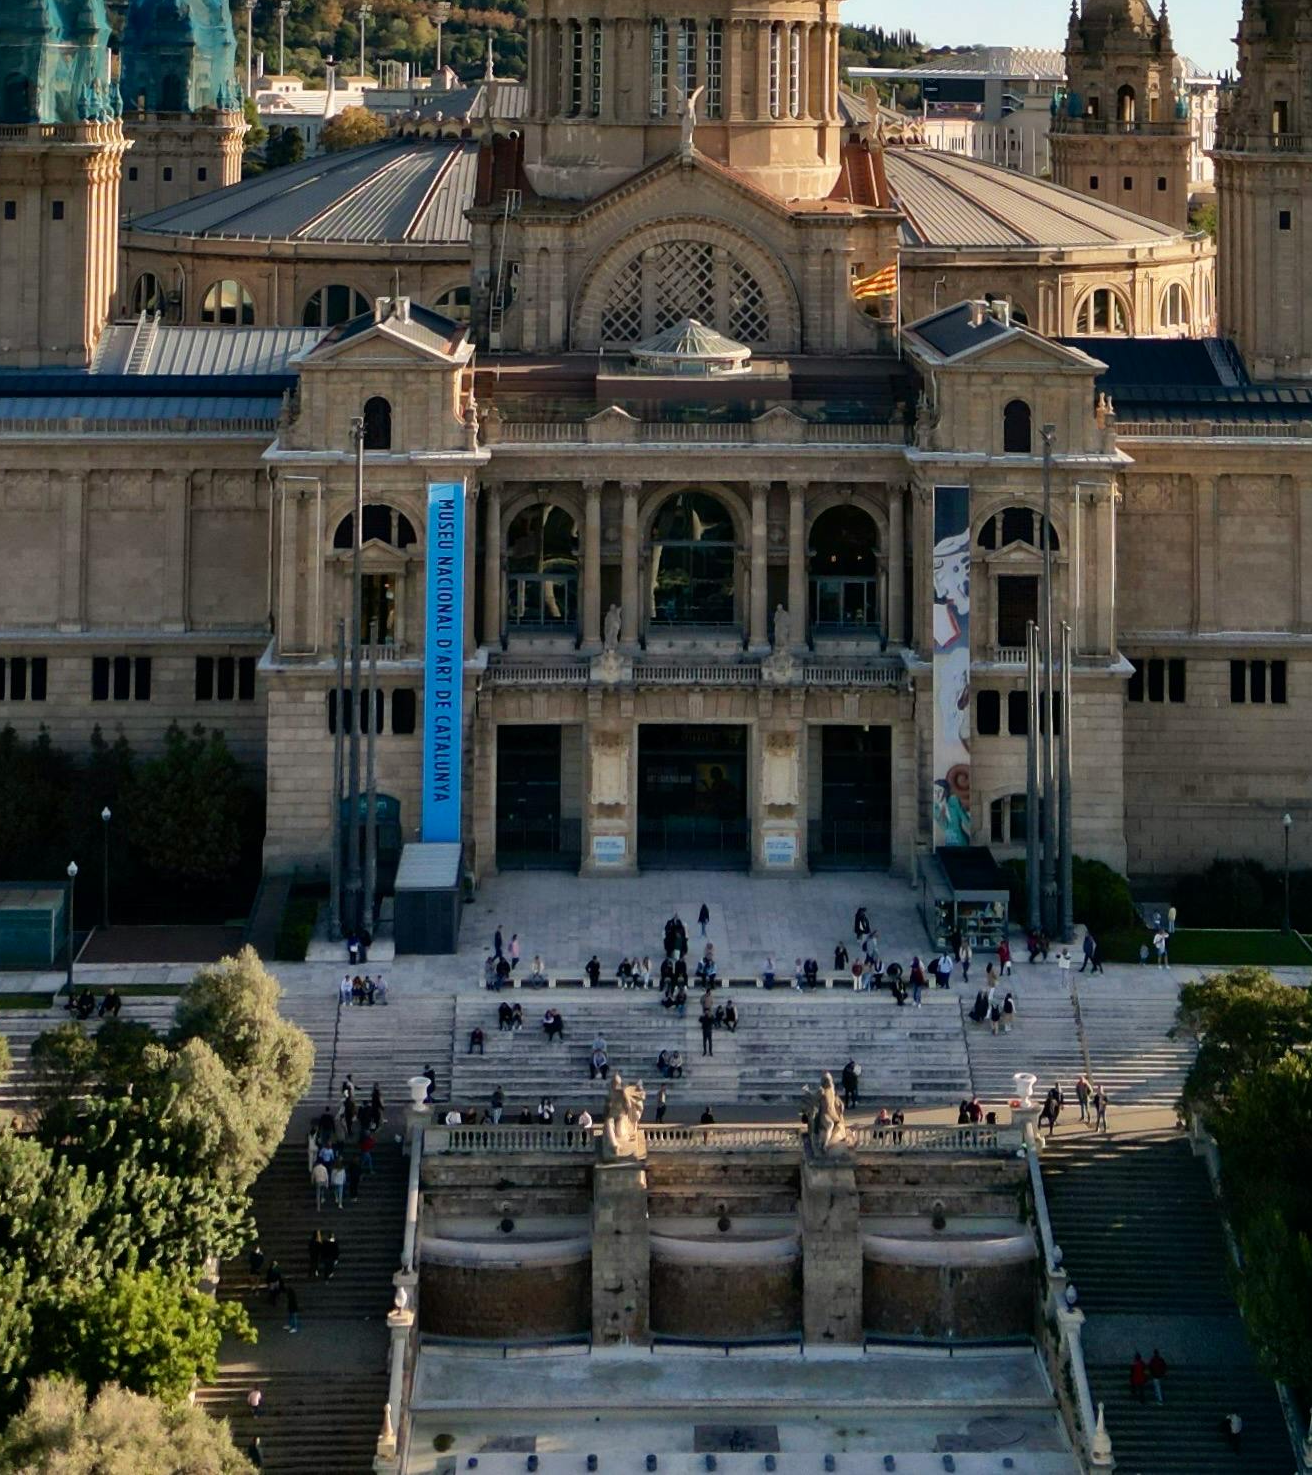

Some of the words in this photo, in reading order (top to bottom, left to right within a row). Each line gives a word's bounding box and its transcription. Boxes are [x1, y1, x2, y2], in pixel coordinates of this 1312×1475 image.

[437, 499, 455, 550] MUSEU
[436, 556, 454, 632] NACIONAL
[435, 639, 453, 683] D'ART
[435, 690, 452, 708] DE
[433, 715, 452, 803] CATALUNYA
